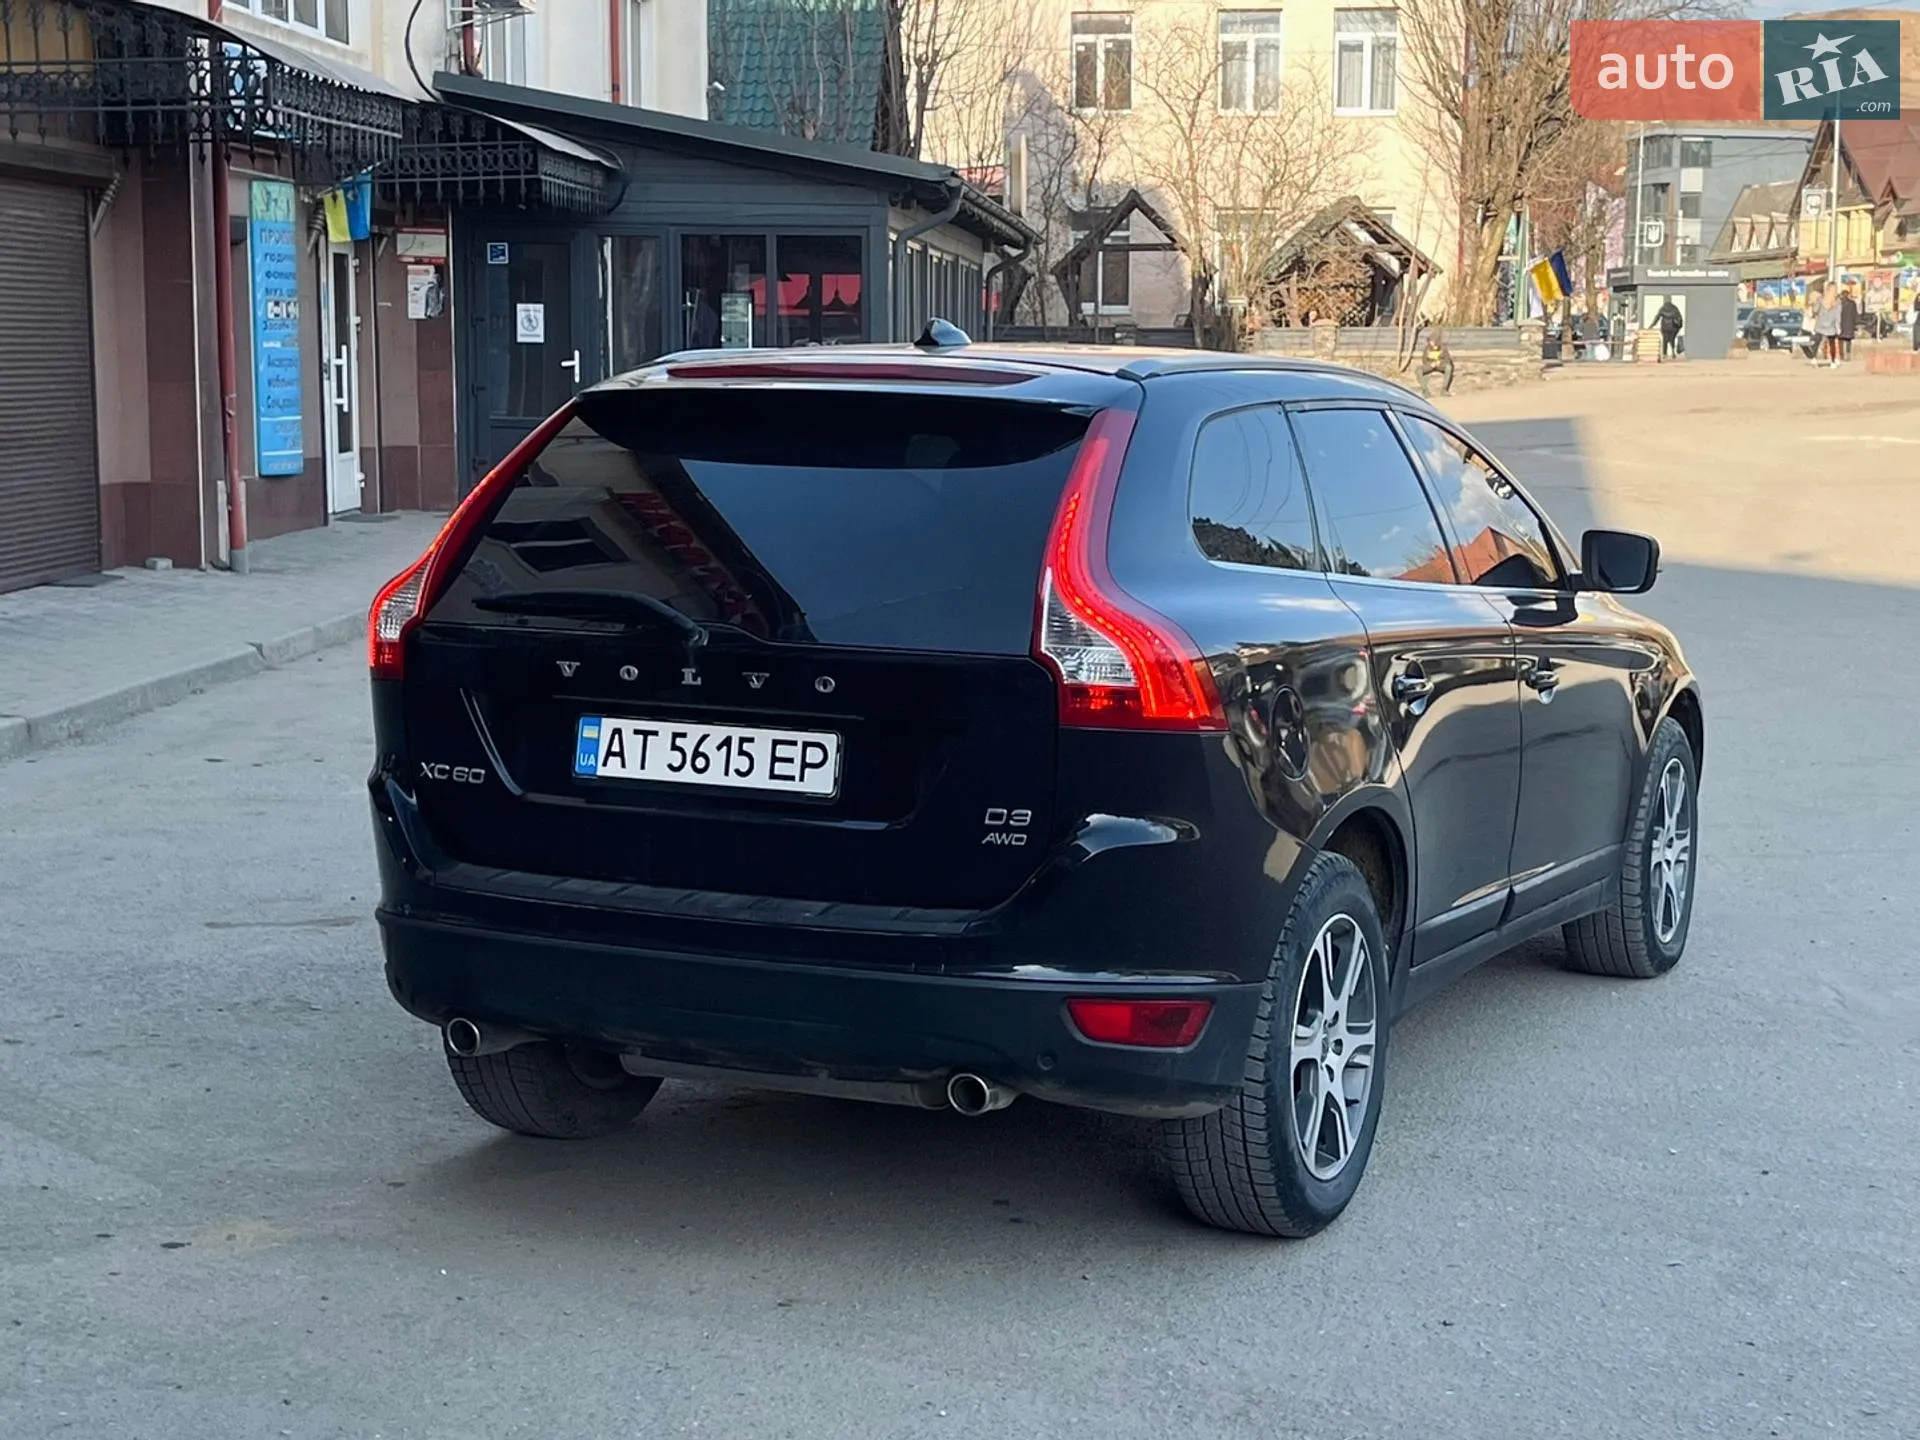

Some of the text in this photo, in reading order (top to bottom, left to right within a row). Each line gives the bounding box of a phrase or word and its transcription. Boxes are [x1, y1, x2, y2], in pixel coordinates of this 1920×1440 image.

[556, 660, 837, 694] VOLVO
[580, 752, 596, 767] UA
[601, 727, 830, 783] AT 5615 EP
[420, 761, 486, 785] XC60
[984, 807, 1032, 826] D3
[981, 832, 1028, 846] AWD
